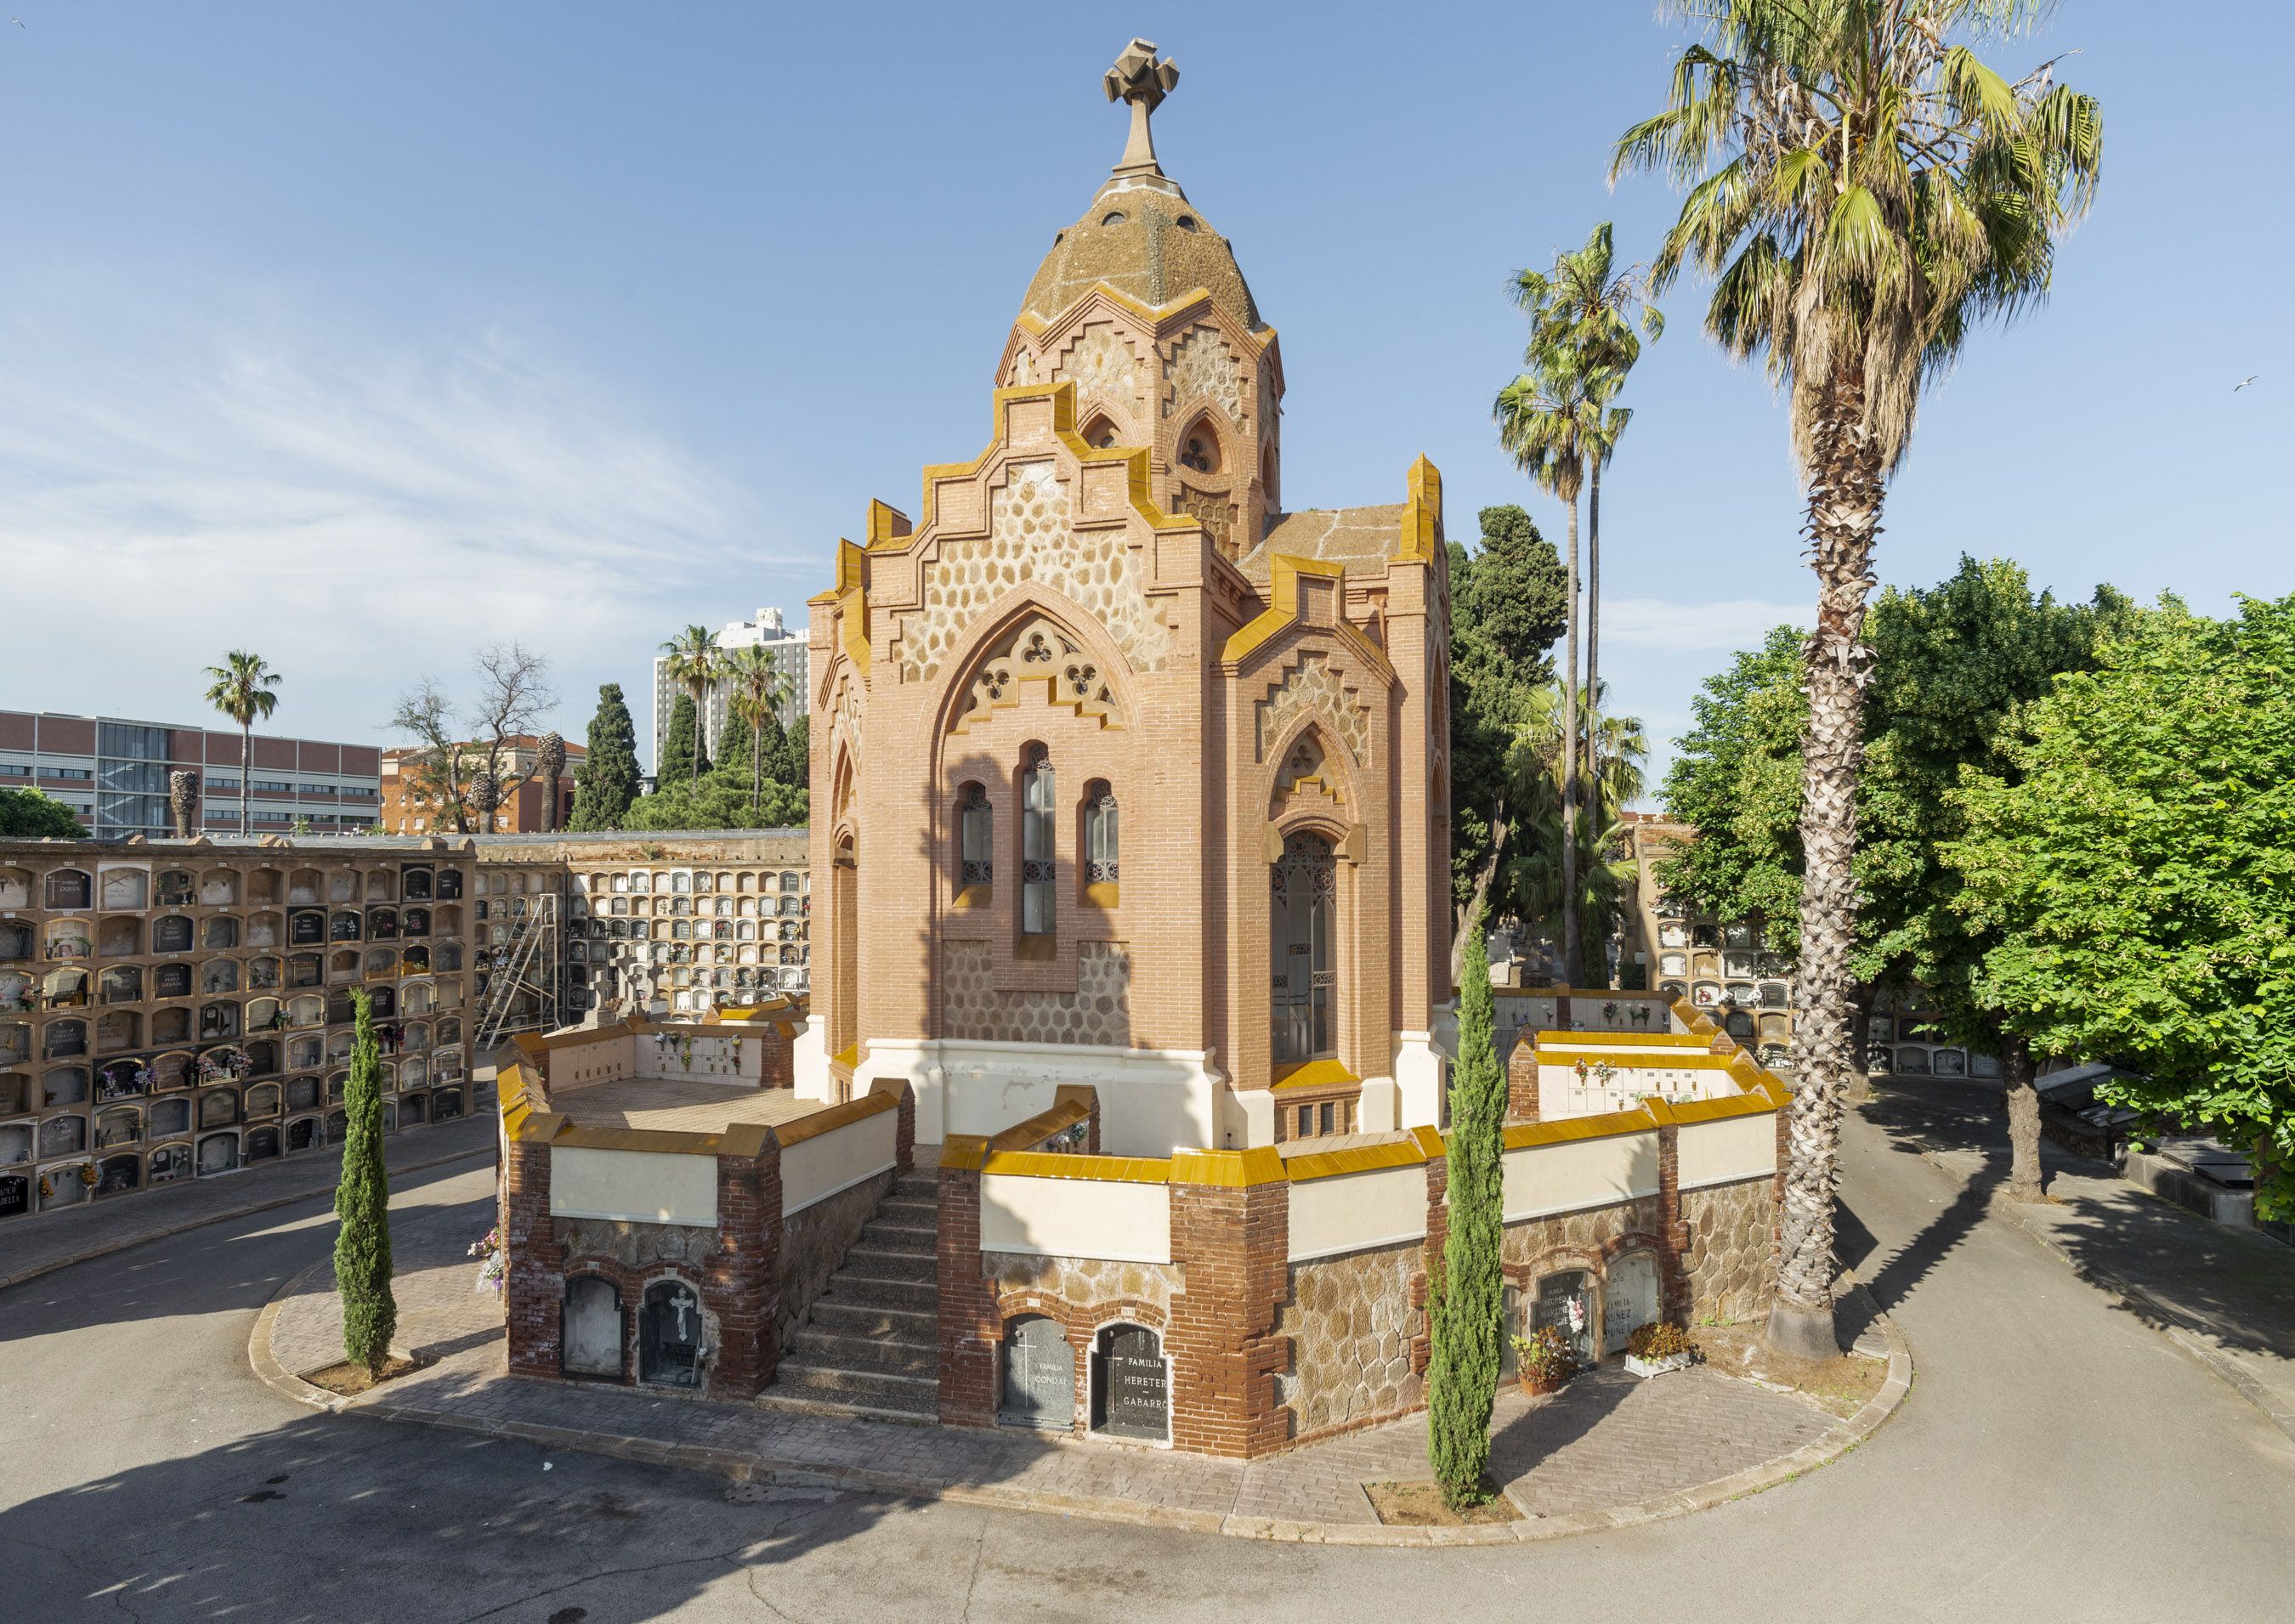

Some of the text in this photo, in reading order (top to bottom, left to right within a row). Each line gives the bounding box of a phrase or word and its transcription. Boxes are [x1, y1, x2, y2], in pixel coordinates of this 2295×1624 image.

[1606, 1298, 1630, 1310] FAMILIA
[1540, 1305, 1569, 1319] MARTINE
[1040, 1363, 1063, 1372] FAMILIA
[1128, 1357, 1162, 1368] FAMILIA
[1124, 1375, 1167, 1388] HERETER
[1124, 1396, 1167, 1409] GABARRÓ
